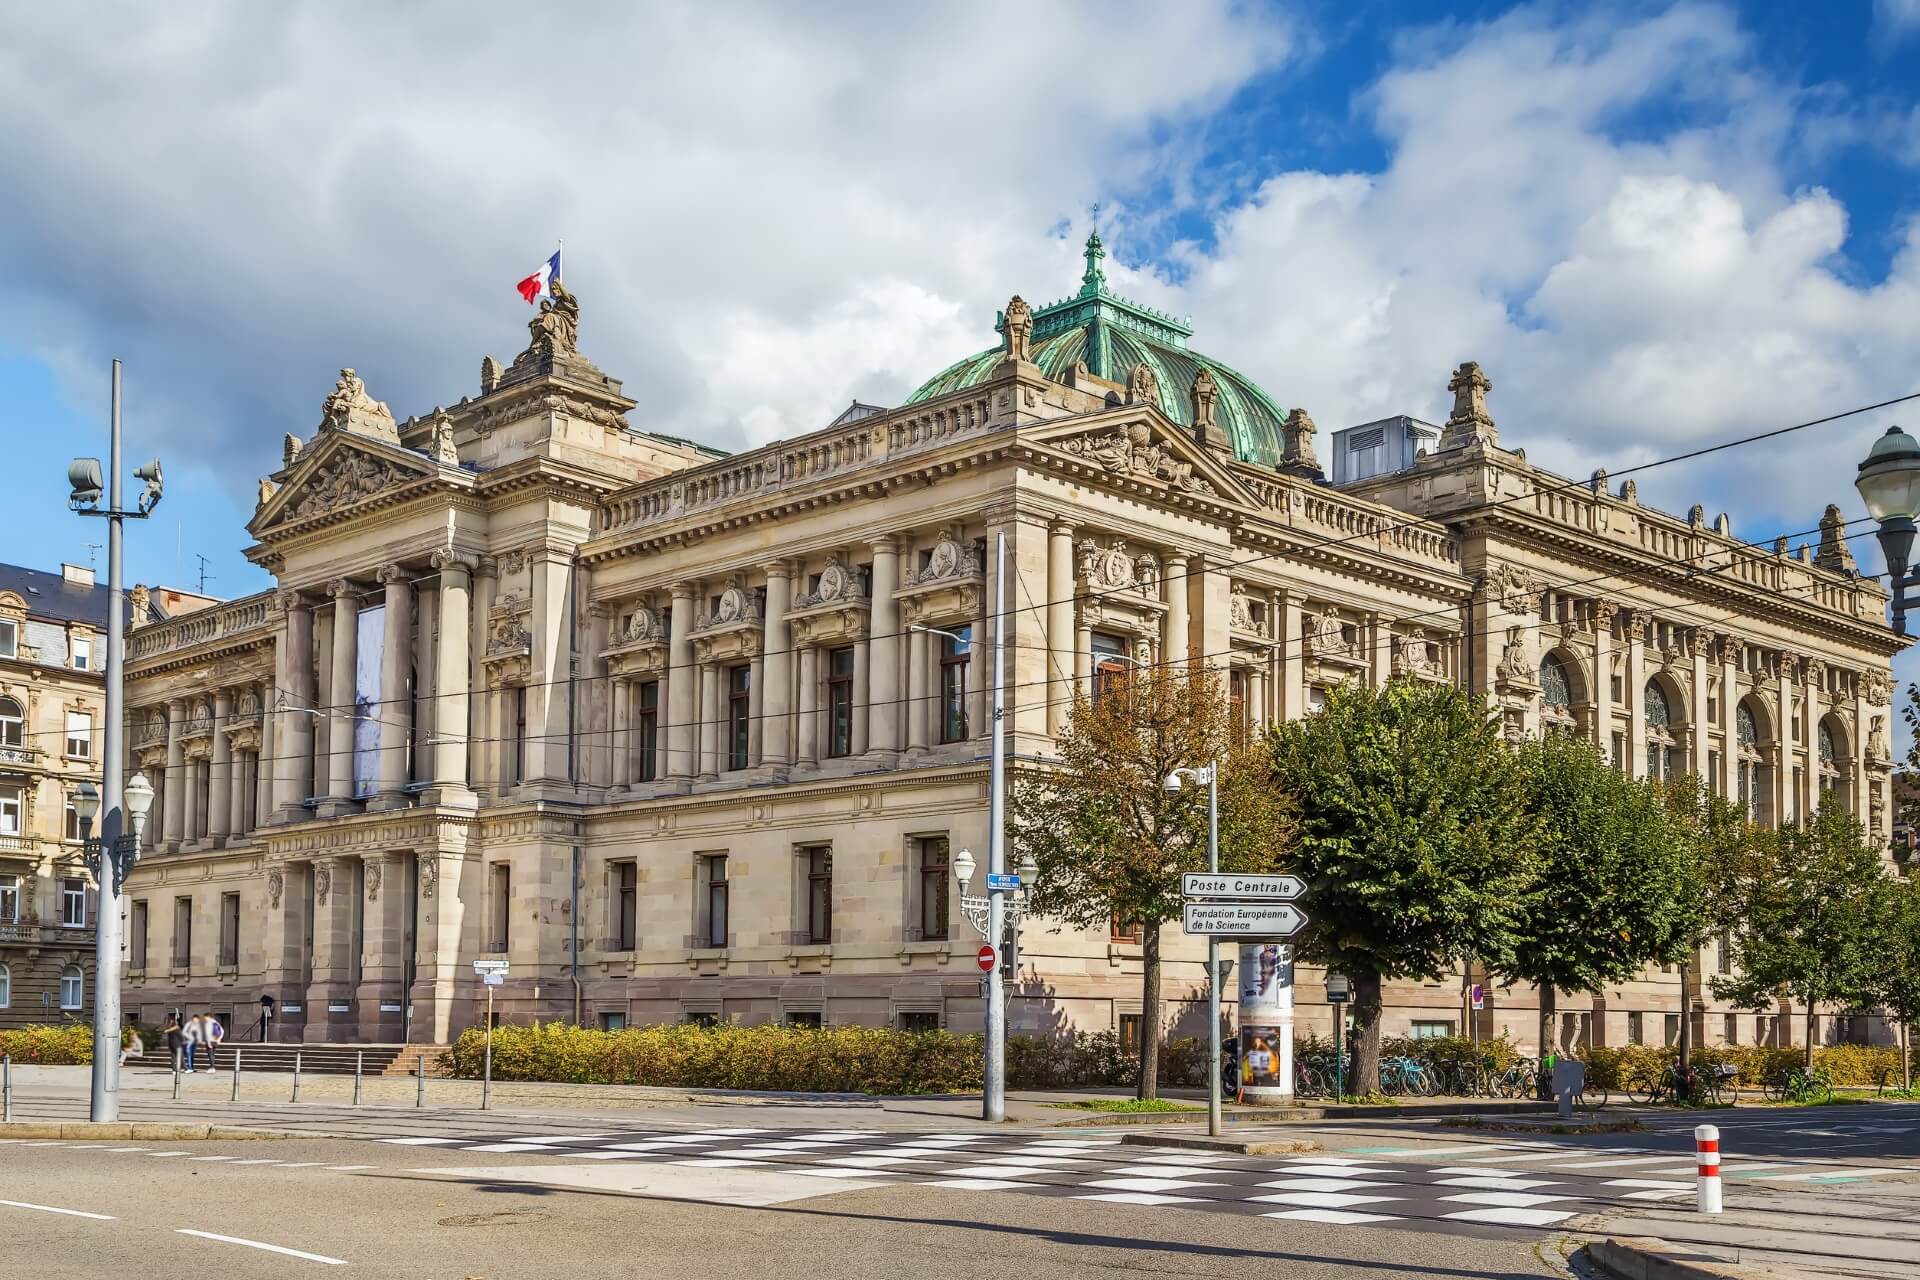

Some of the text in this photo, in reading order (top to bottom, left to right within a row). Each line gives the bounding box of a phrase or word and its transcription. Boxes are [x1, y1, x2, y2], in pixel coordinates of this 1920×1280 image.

[1190, 879, 1290, 893] Poste Centrale
[1191, 908, 1288, 920] Fondation Européenne
[1192, 921, 1250, 930] de la Science
